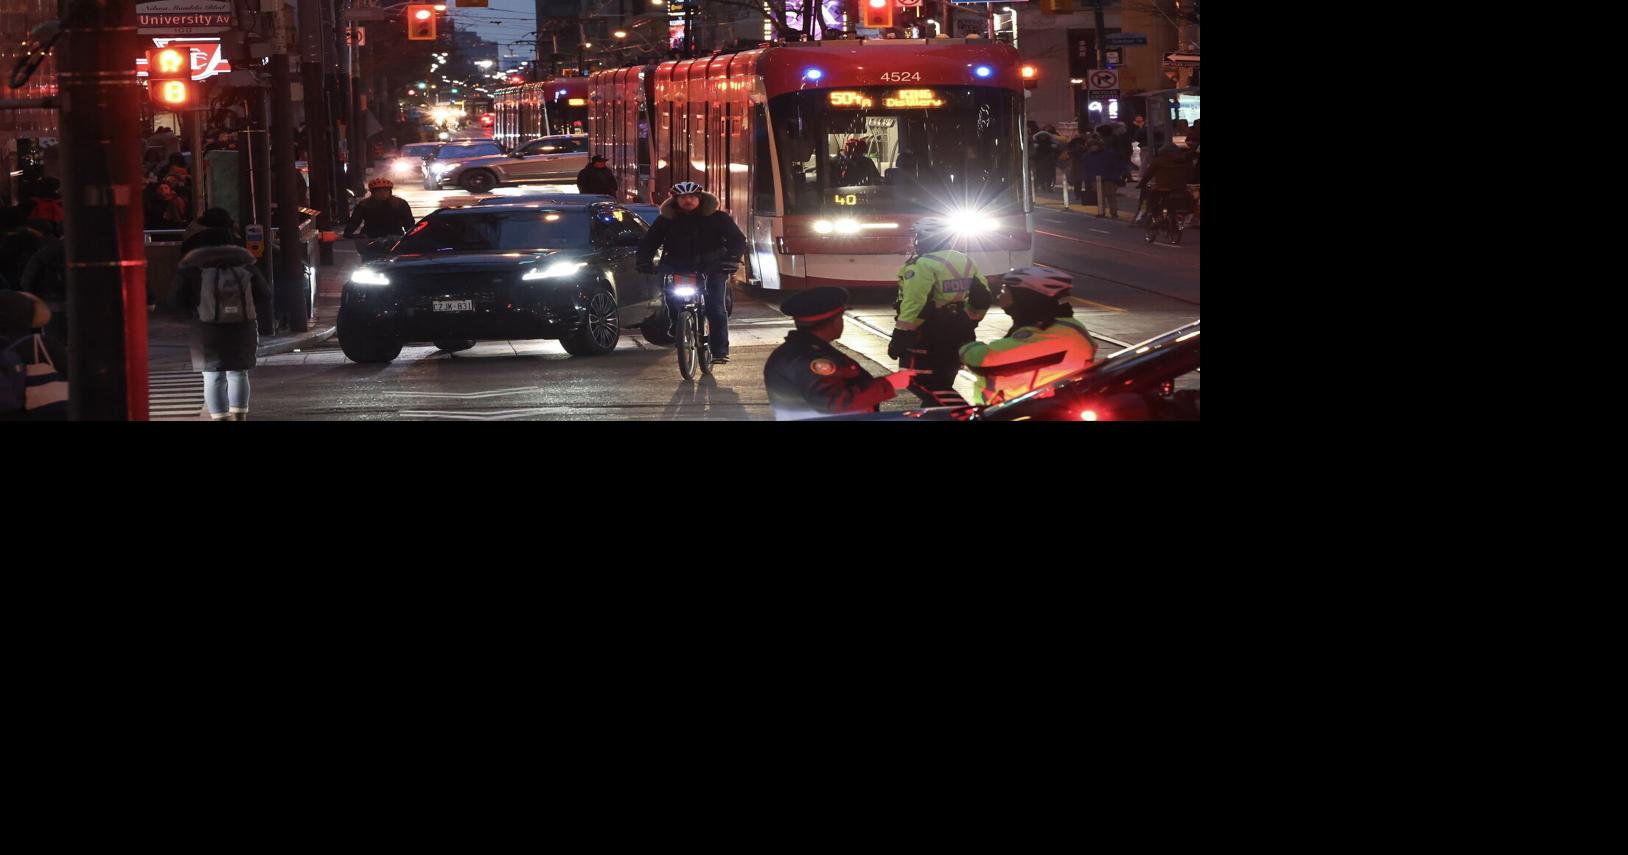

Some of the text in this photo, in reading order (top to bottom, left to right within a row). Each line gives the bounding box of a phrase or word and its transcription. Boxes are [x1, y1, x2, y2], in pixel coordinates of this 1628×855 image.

[140, 14, 230, 25] University Av
[880, 71, 921, 82] 4524
[898, 89, 935, 99] KING
[886, 98, 943, 107] Distillery
[834, 194, 857, 206] 40
